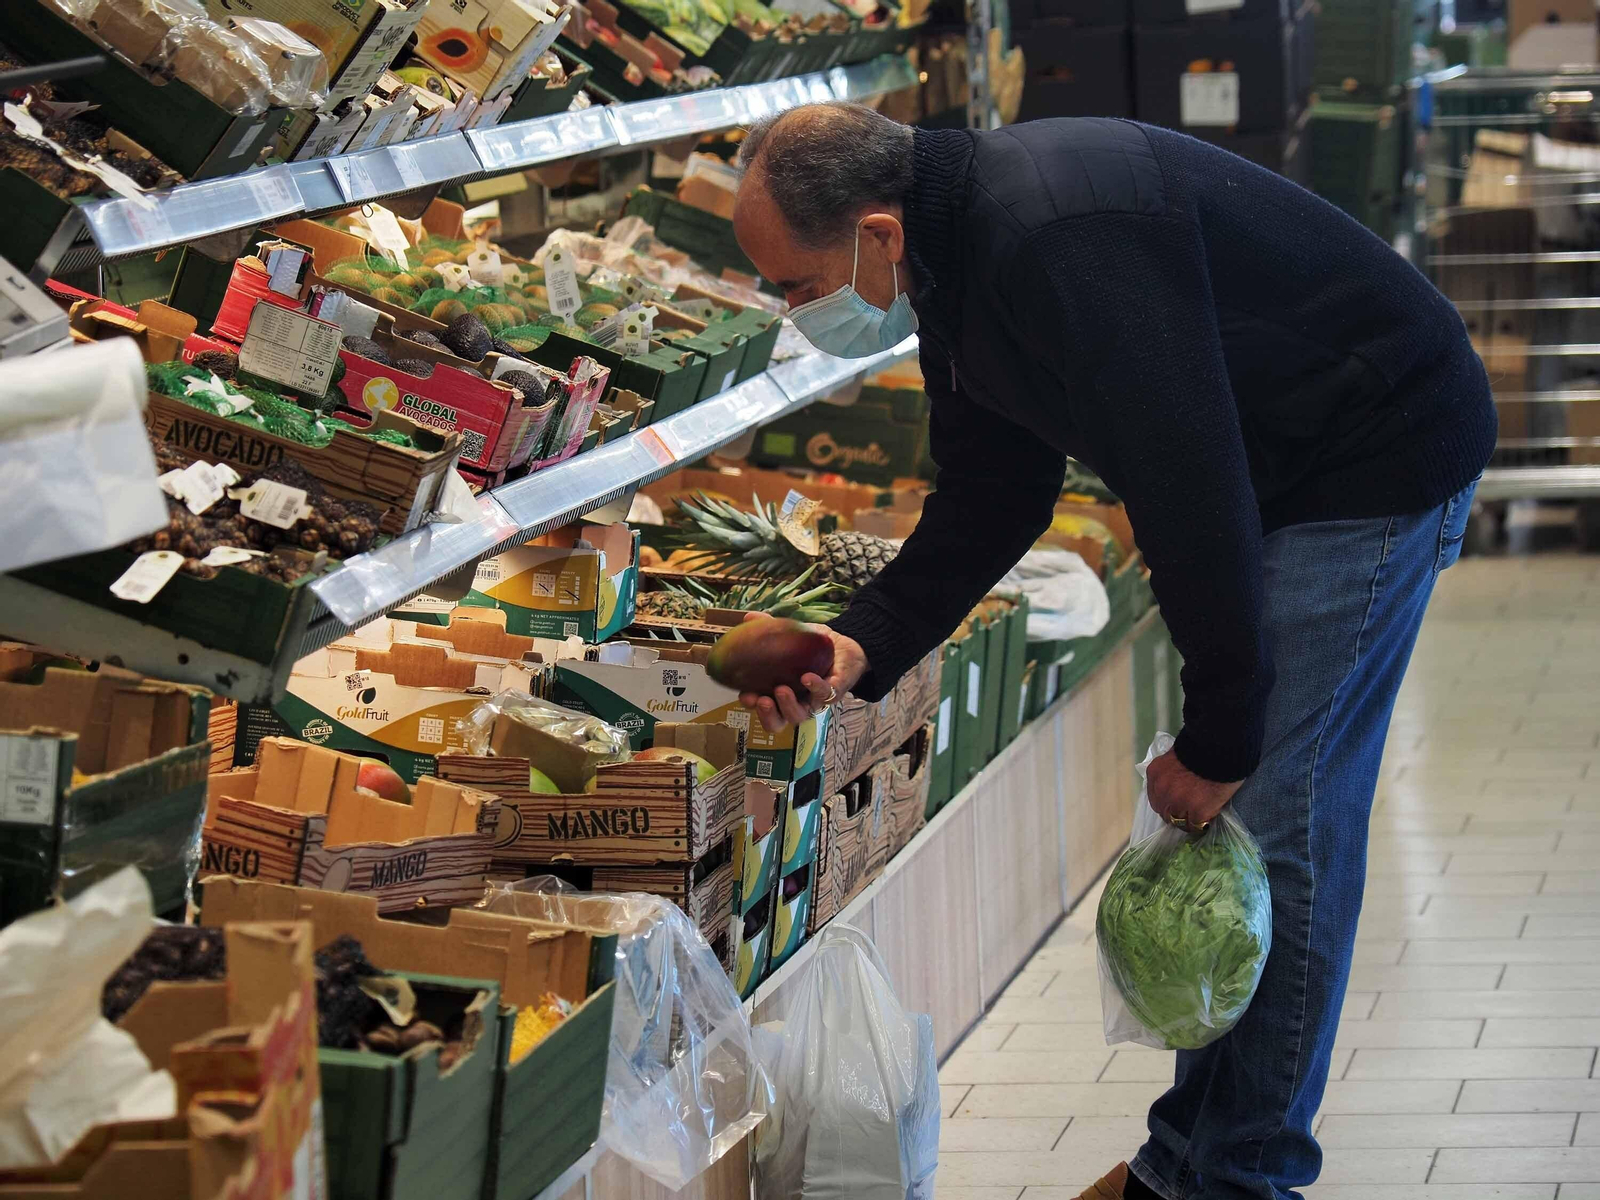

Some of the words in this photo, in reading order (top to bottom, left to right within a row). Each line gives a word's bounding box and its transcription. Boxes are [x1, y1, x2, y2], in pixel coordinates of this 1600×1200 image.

[335, 0, 360, 19] PRODUCT
[340, 10, 358, 25] BRAZIL
[313, 367, 324, 377] Kg
[398, 406, 456, 432] AVOCADOS
[402, 393, 458, 424] GLOBAL
[163, 418, 284, 469] AVOCADO
[806, 432, 891, 469] Organic
[336, 706, 390, 722] GoldFruit
[647, 699, 699, 714] GoldFruit
[303, 727, 332, 736] BRAZIL
[616, 720, 644, 729] BRAZIL
[547, 806, 650, 840] MANGO
[199, 842, 260, 878] NGO
[370, 850, 427, 889] MANGO
